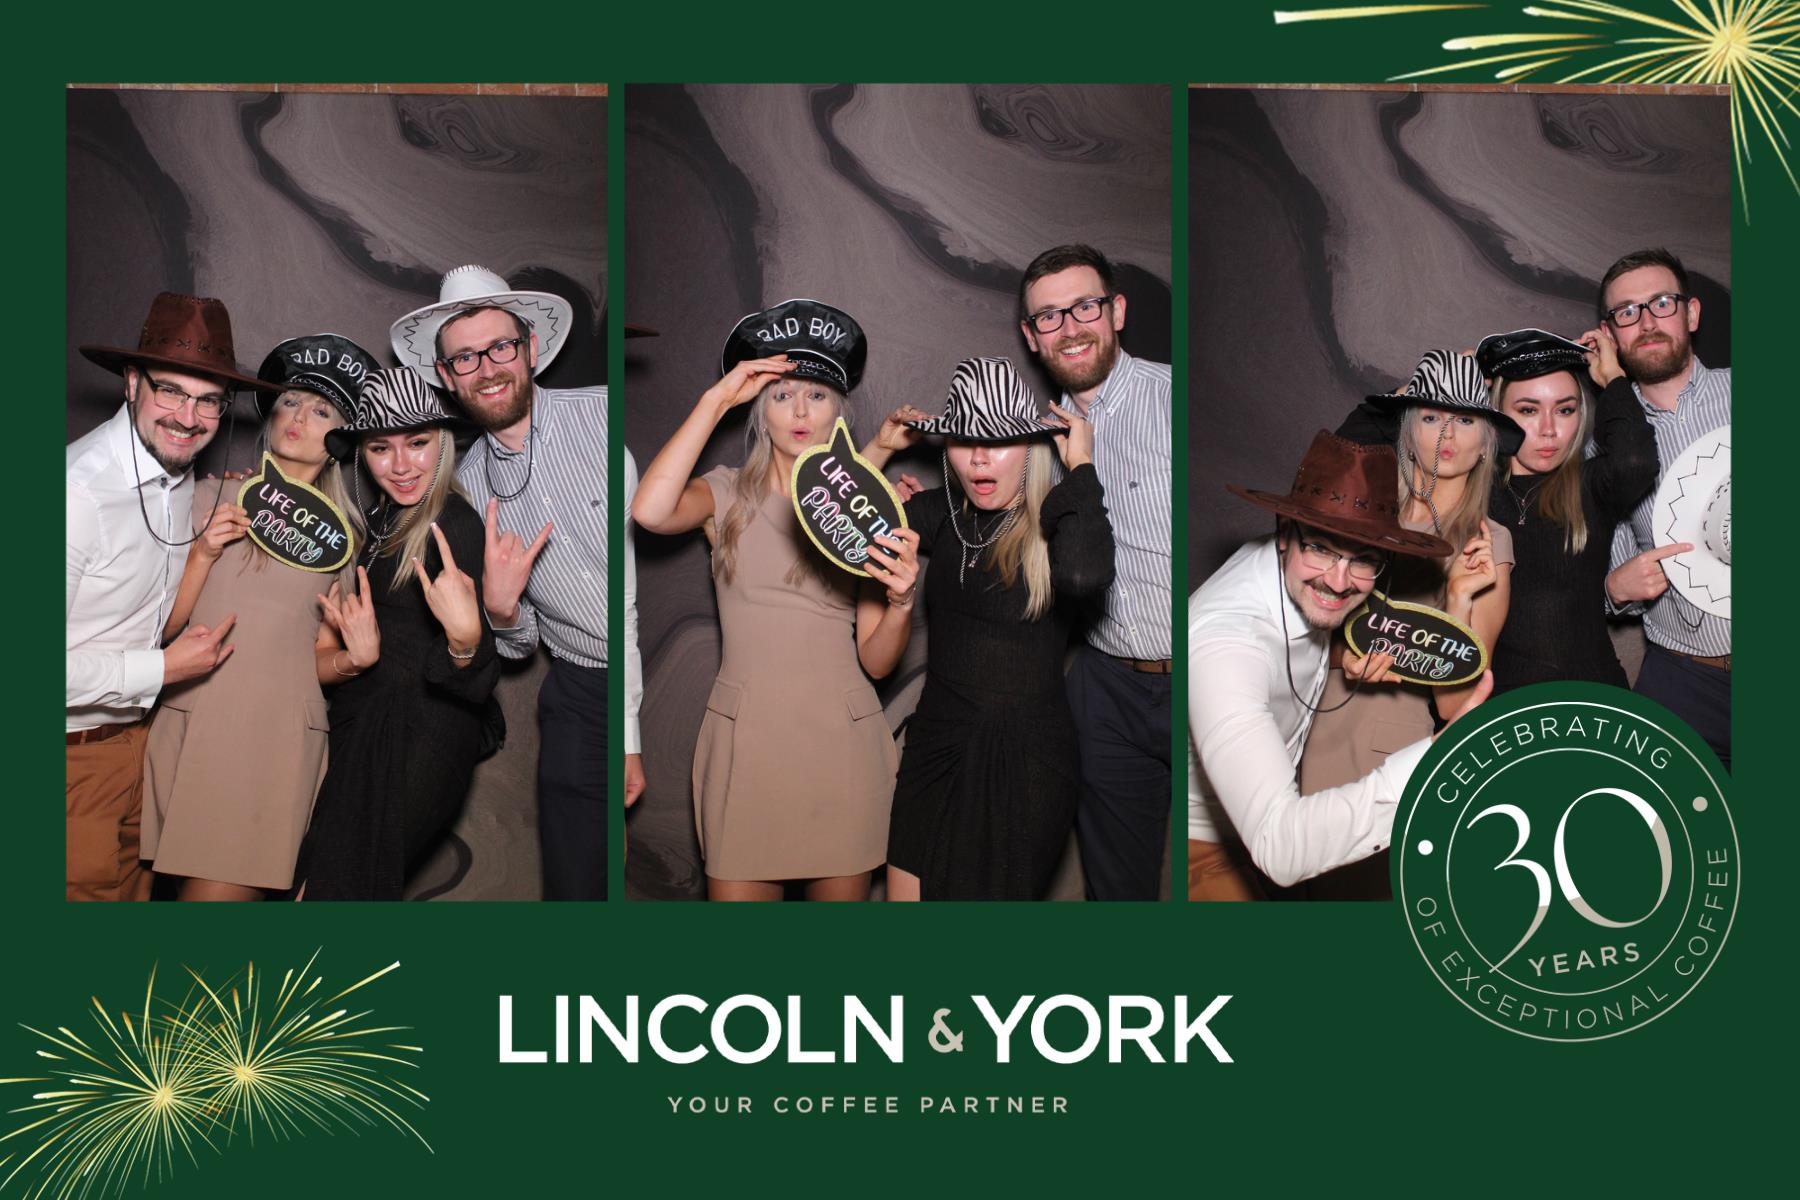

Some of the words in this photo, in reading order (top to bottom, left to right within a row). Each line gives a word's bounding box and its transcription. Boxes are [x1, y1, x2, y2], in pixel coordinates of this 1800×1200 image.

[809, 317, 847, 345] BOY
[820, 456, 859, 499] LIFE
[850, 495, 878, 519] OF
[251, 509, 324, 563] PARTY
[259, 483, 296, 515] LIFE
[293, 508, 319, 528] OF
[314, 520, 347, 550] THE
[801, 486, 869, 563] PARTY
[1367, 612, 1411, 639] LIFE
[1411, 629, 1441, 648] OF
[1440, 637, 1477, 662] THE
[1367, 637, 1454, 680] PARTY
